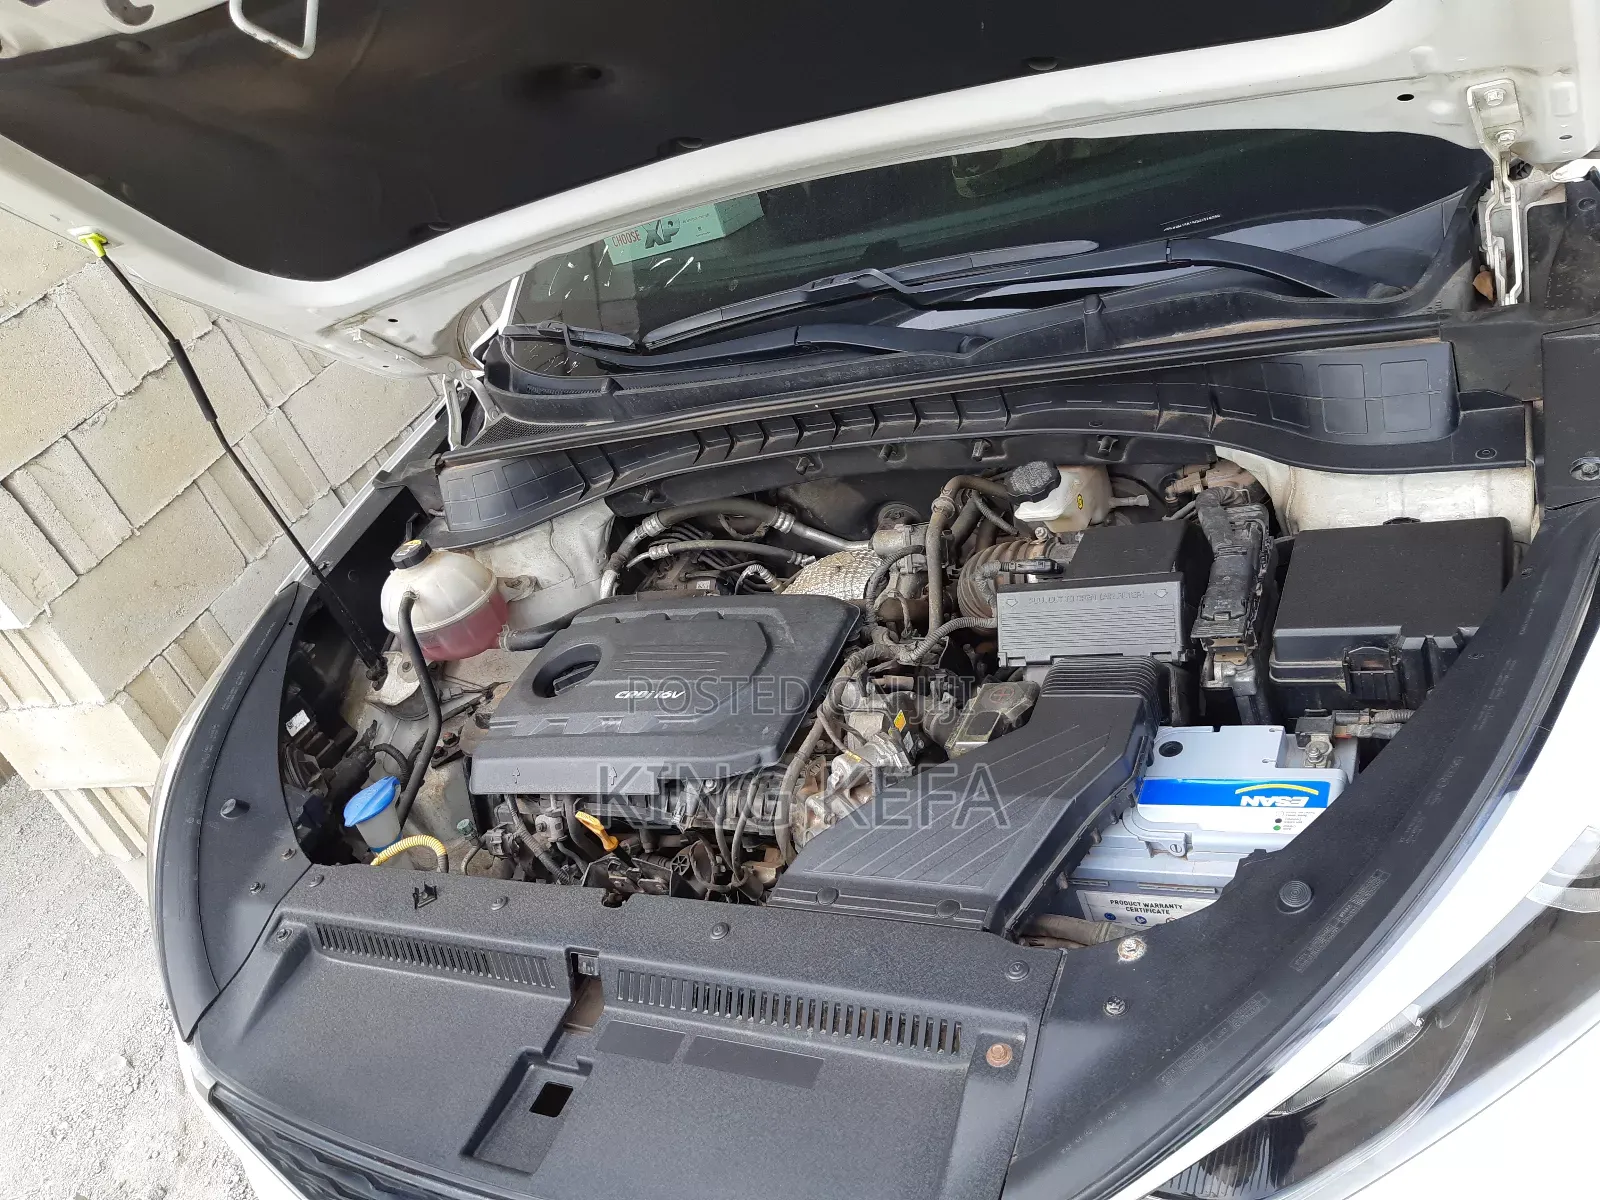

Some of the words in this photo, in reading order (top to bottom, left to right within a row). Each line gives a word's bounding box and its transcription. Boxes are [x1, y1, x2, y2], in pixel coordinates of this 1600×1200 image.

[611, 229, 641, 247] CHOOSE
[642, 219, 680, 249] XP
[1240, 795, 1310, 807] ESAN
[1109, 899, 1141, 907] PRODUCT
[1142, 902, 1183, 910] WARRANTY
[1125, 906, 1171, 915] CERTIFICATE
